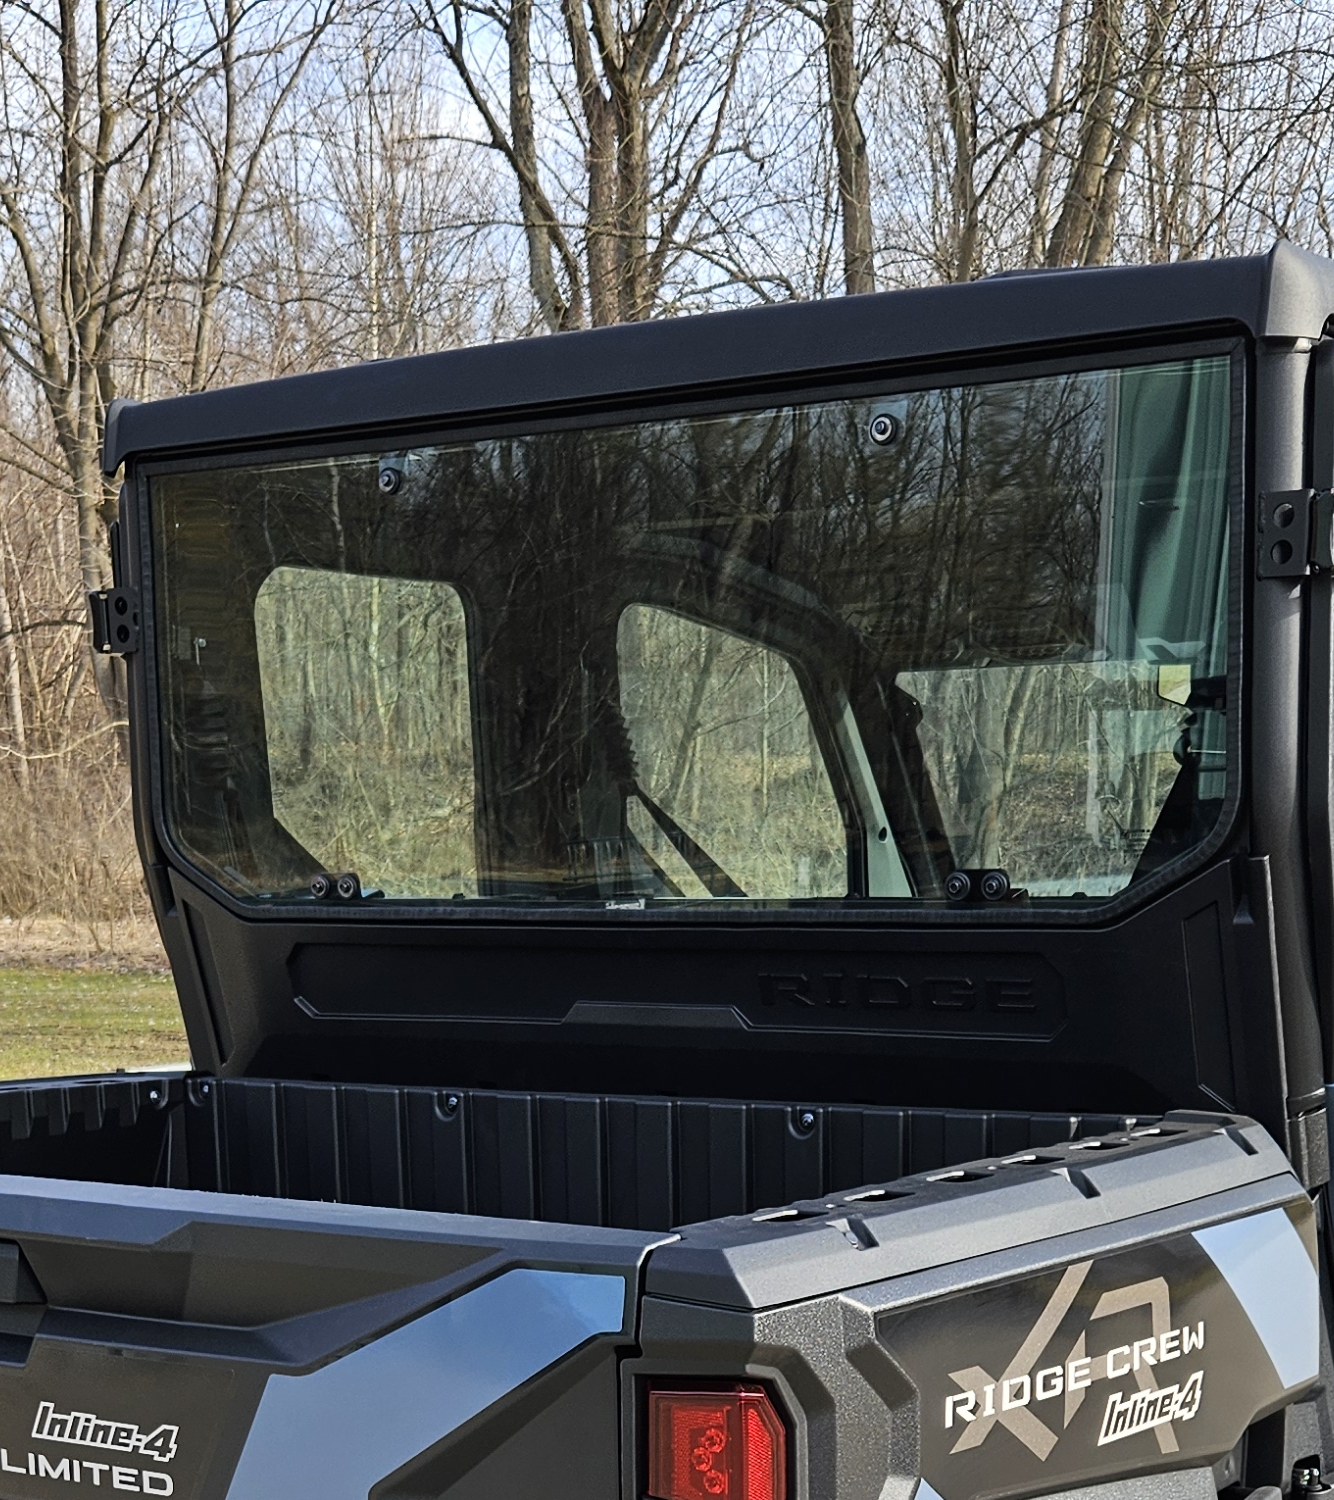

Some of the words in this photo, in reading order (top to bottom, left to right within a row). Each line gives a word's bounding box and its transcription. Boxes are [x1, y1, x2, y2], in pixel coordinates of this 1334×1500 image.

[757, 973, 1037, 1008] RIDGE
[945, 1357, 1092, 1428] RIDGE
[1106, 1321, 1205, 1380] CREW
[32, 1401, 179, 1462] Inline-4
[1097, 1370, 1205, 1446] Inline-4
[0, 1448, 174, 1497] LIMITED
